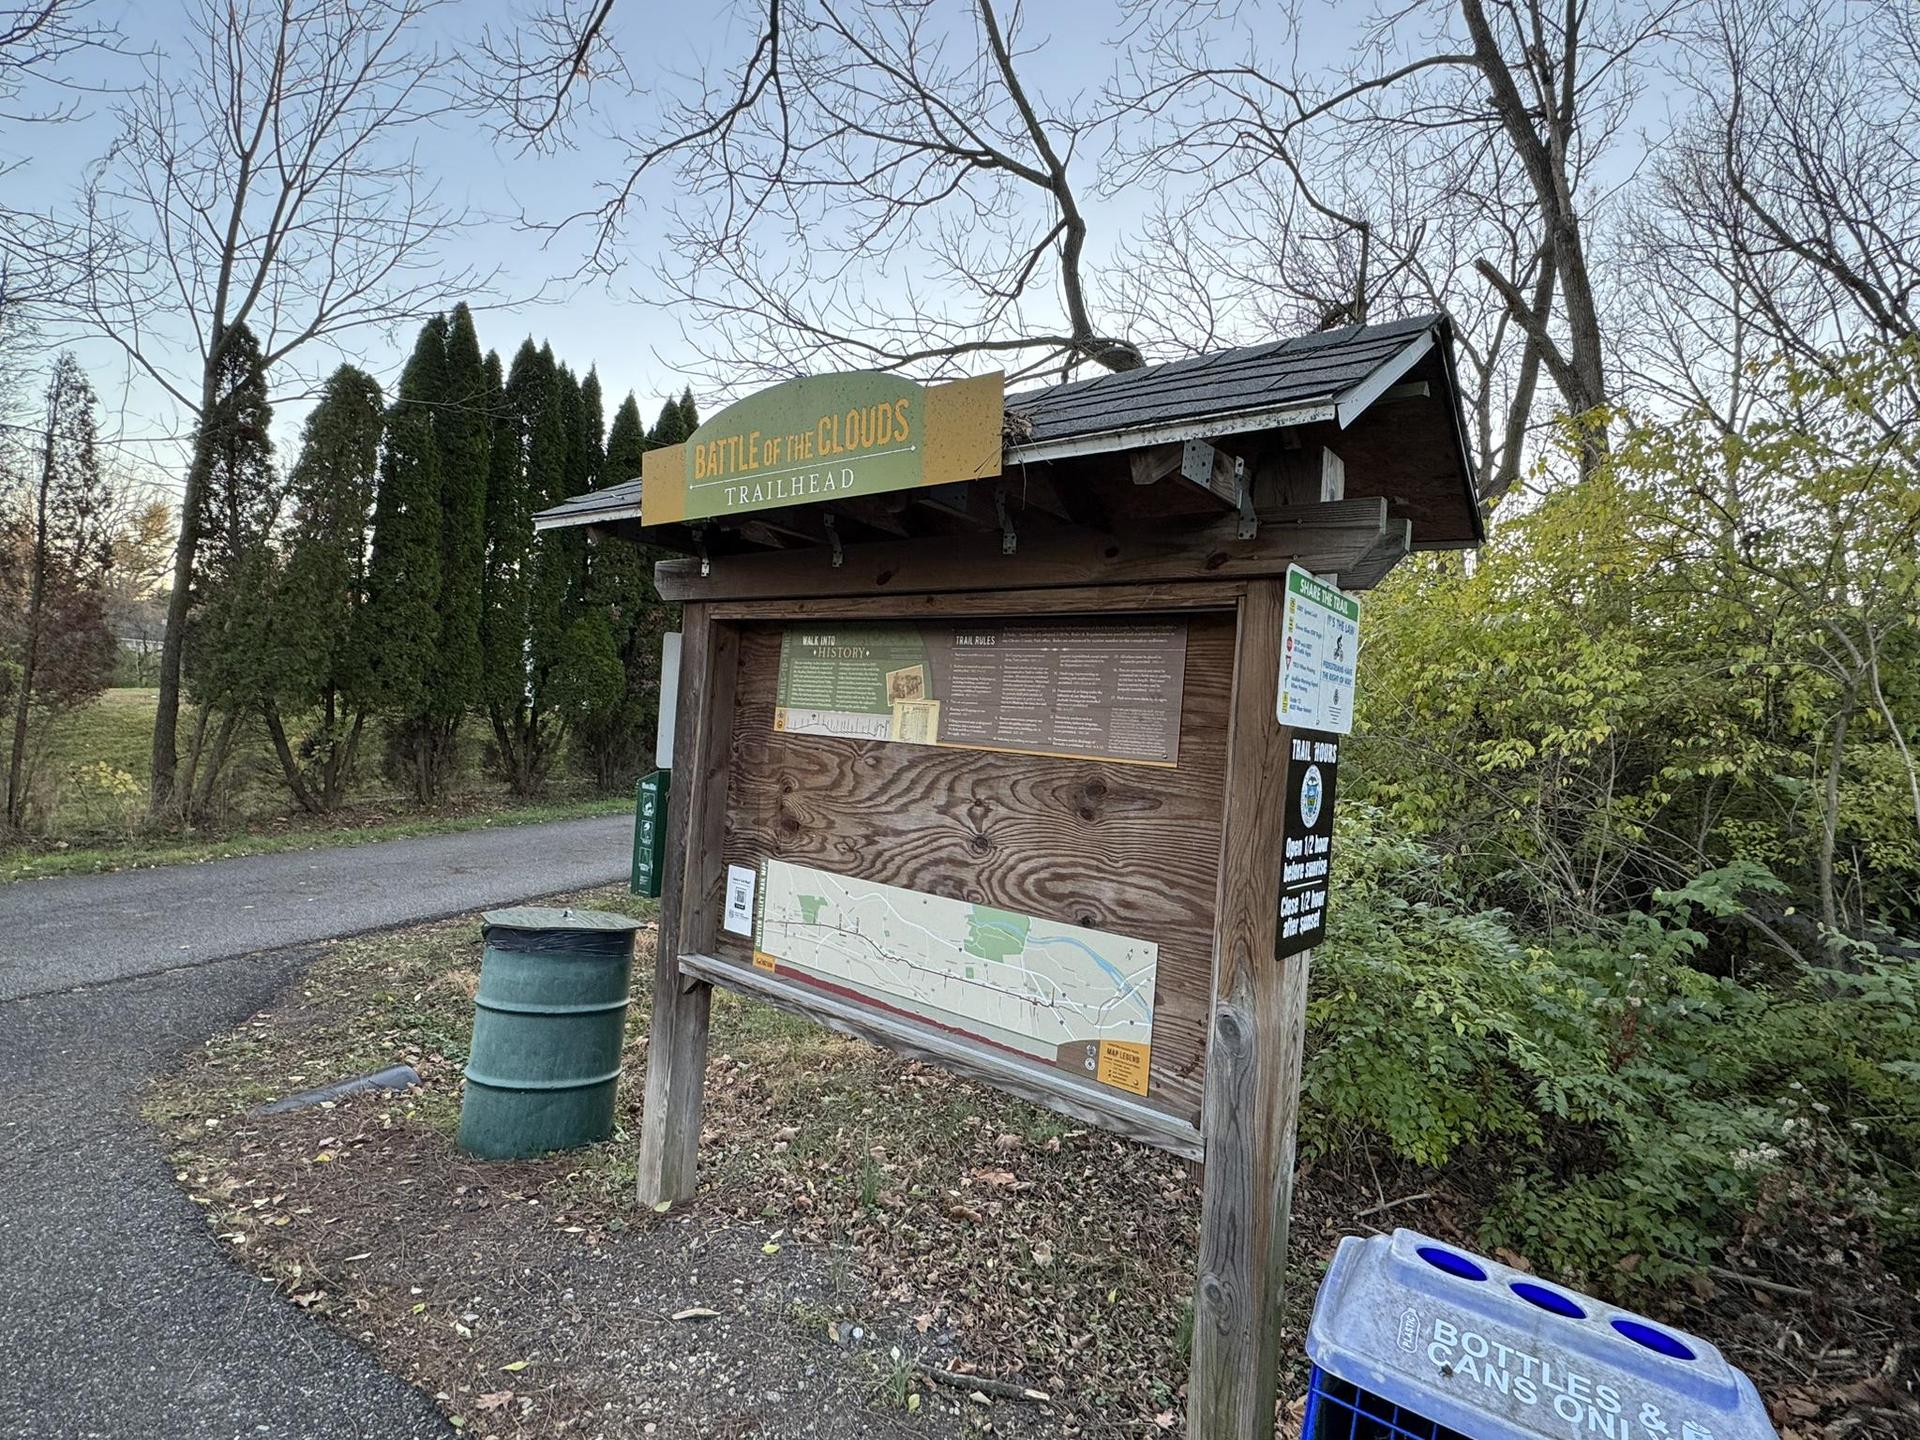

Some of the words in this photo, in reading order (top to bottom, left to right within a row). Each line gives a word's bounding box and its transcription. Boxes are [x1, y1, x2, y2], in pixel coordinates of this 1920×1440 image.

[695, 431, 760, 480] BATTLE
[763, 437, 781, 466] OF
[785, 430, 813, 461] THE
[817, 399, 910, 457] CLOUDS
[724, 468, 855, 506] TRAILHEAD
[1300, 578, 1321, 601] SHARE
[1321, 589, 1332, 607] THE
[1333, 595, 1348, 614] TRAIL
[802, 635, 819, 646] WALK
[820, 635, 836, 646] INTO
[817, 647, 866, 659] HISTORY
[956, 636, 973, 645] TRAIL
[974, 636, 996, 646] RULES
[1292, 738, 1311, 761] TRAIL
[1313, 741, 1338, 764] HOURS
[1285, 837, 1303, 860] Open
[1304, 834, 1314, 856] 1/2
[1314, 834, 1329, 854] hour
[1283, 861, 1304, 883] before
[1304, 857, 1328, 878] sunrise
[757, 895, 765, 918] VALLEY
[1280, 896, 1299, 918] Close
[1300, 890, 1311, 913] 1/2
[1310, 889, 1326, 909] hour
[1106, 1047, 1119, 1057] MAP
[1119, 1051, 1140, 1064] LEGEND
[1402, 1315, 1415, 1349] PLASTIC
[1428, 1341, 1537, 1405] CANS
[1433, 1319, 1622, 1414] BOTTLES
[1639, 1402, 1669, 1434] &
